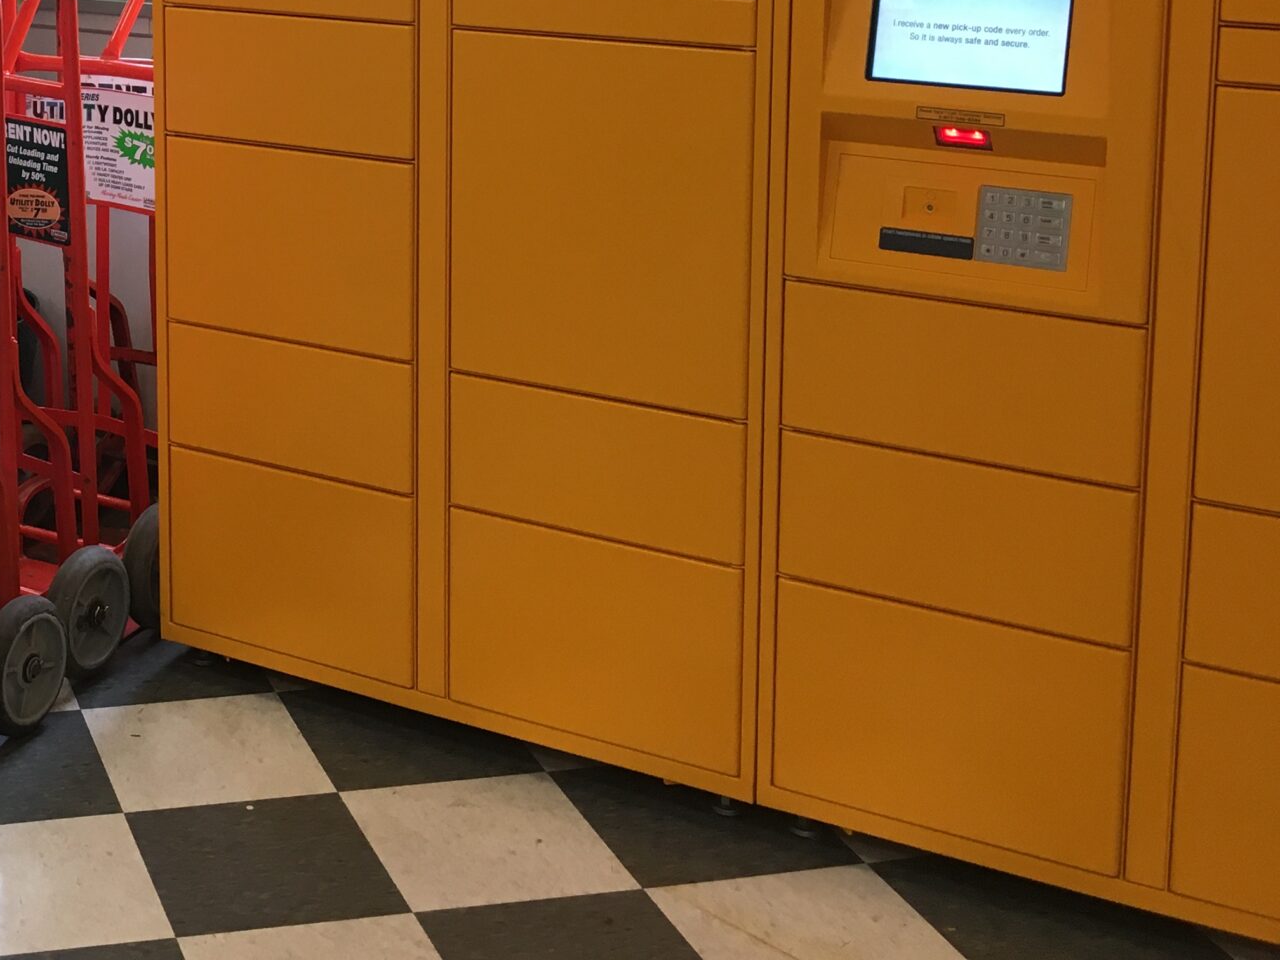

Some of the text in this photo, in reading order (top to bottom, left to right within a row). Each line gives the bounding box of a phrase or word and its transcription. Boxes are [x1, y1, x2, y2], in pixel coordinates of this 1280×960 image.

[897, 20, 925, 29] receive
[951, 22, 982, 33] pick-up
[984, 25, 1003, 34] code
[1005, 28, 1026, 37] every
[1028, 28, 1050, 37] order.
[909, 32, 920, 40] So
[921, 33, 927, 41] it
[937, 34, 963, 44] always
[964, 36, 982, 45] safe
[983, 37, 999, 46] and
[1001, 40, 1030, 48] secure.
[113, 106, 154, 130] DOLL
[33, 128, 65, 149] NOW!
[6, 144, 59, 162] Cut Loading and
[8, 155, 58, 173] Unloading Time
[21, 170, 46, 182] by 50%
